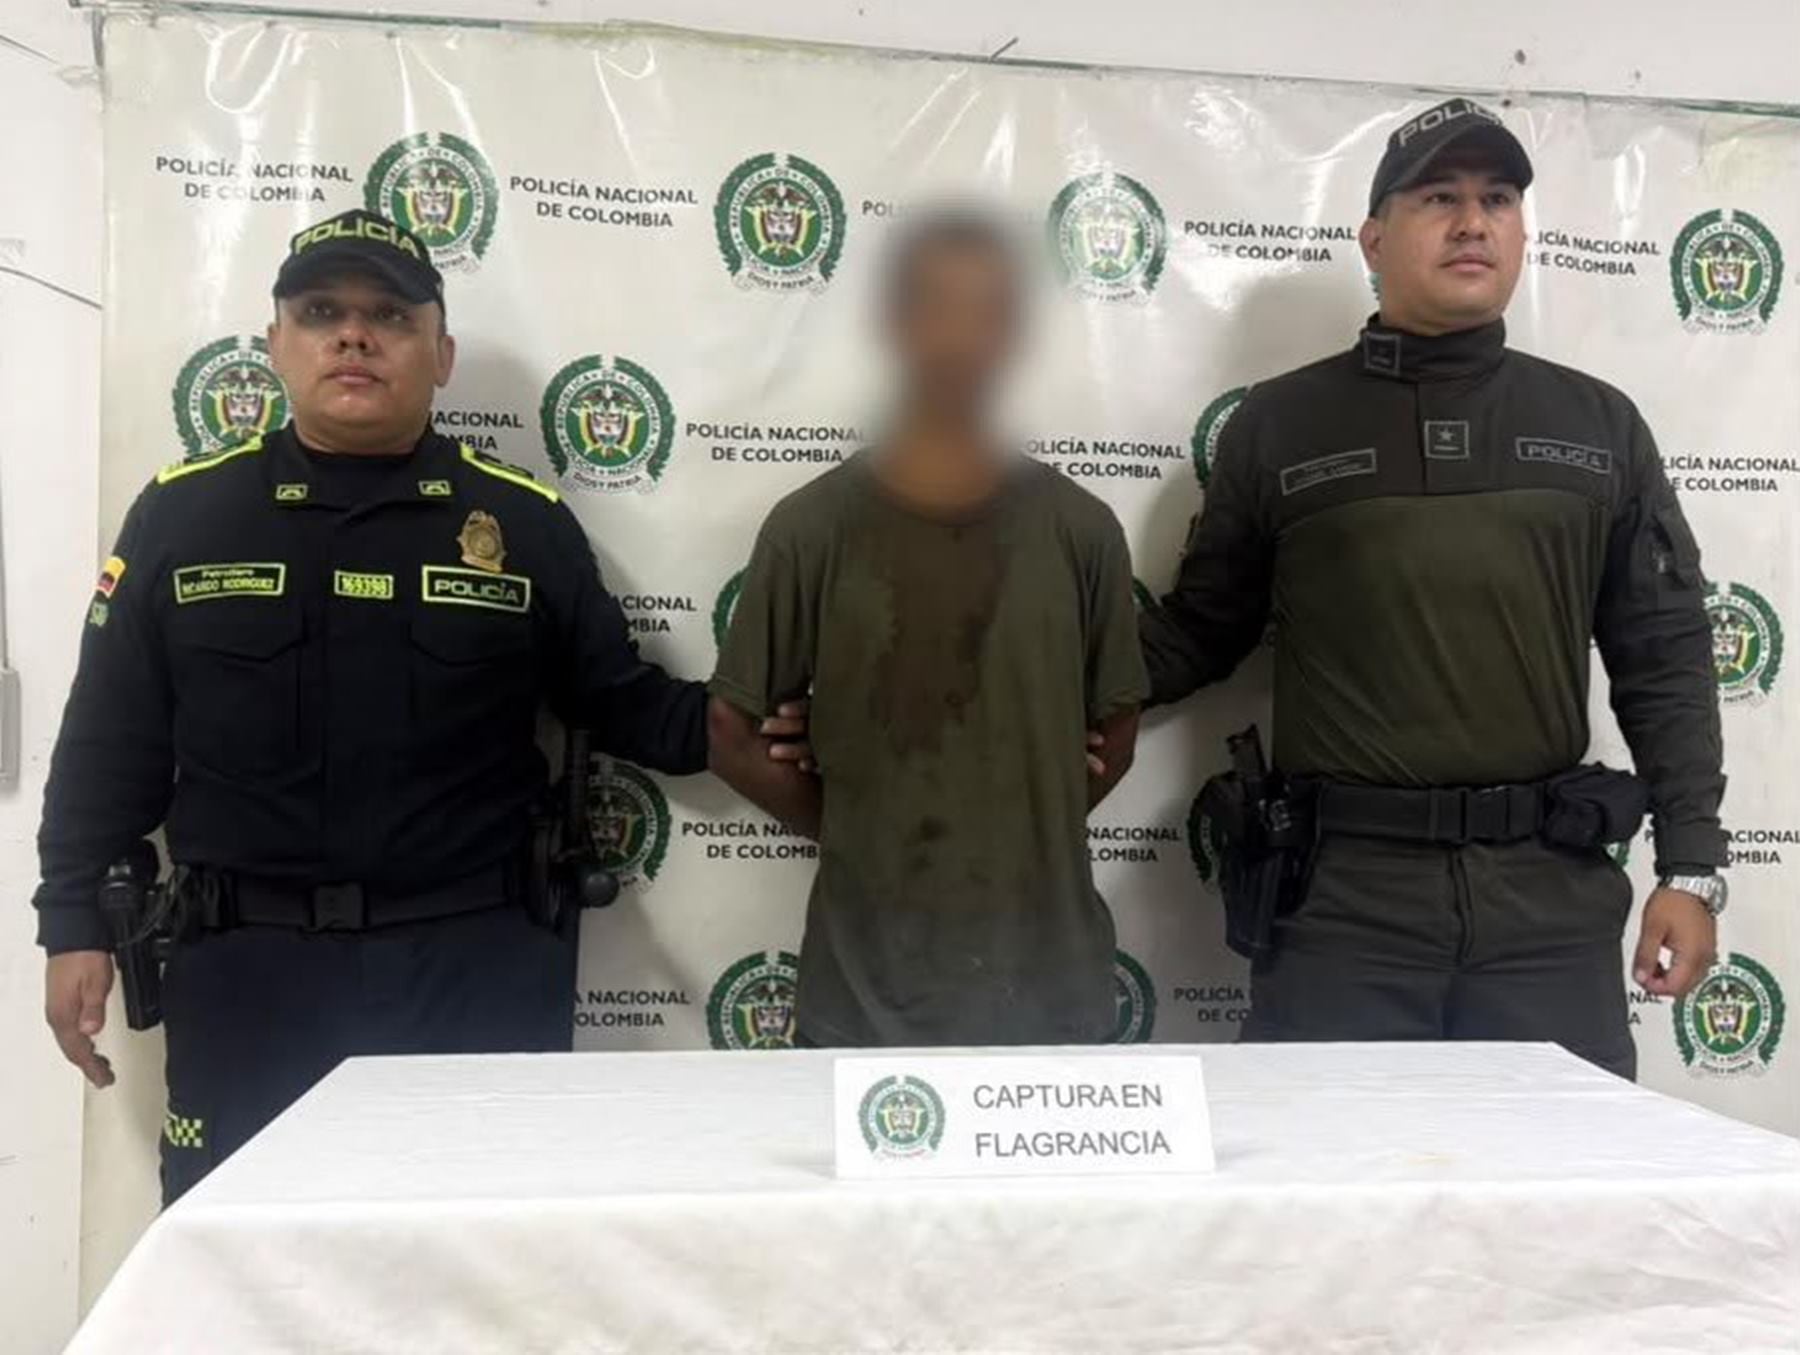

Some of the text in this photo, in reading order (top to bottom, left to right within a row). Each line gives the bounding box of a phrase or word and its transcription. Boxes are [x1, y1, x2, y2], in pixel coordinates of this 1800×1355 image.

[1399, 102, 1503, 147] POLIC
[156, 156, 354, 182] POLICÍA NACIONAL
[184, 183, 210, 198] DE
[510, 176, 699, 204] POLICÍA NACIONAL
[536, 201, 673, 227] DE COLOMBIA
[1184, 220, 1357, 240] POLICÍA NACIONAL
[1538, 229, 1661, 256] ICÍA NACIONAL
[1208, 244, 1332, 262] DE COLOMBIA
[1554, 254, 1637, 276] COLOMBIA
[433, 411, 525, 429] ACIONAL
[686, 423, 763, 441] POLICÍA
[711, 447, 843, 463] DE COLOMBIA
[1026, 437, 1186, 460] OLICÍA NACIONAL
[1067, 463, 1162, 479] COLOMBIA
[1662, 454, 1800, 472] LICÍA NACIONAL
[1672, 477, 1778, 492] E COLOMBIA
[434, 578, 520, 604] POLICÍA
[622, 595, 698, 612] CIONAL
[626, 618, 670, 632] MBIA
[682, 819, 758, 837] POLICÍA
[1086, 827, 1182, 841] NACIONAL
[707, 845, 818, 859] DE COLOMB
[1088, 847, 1159, 863] LOMBIA
[1725, 850, 1782, 864] OMBIA
[588, 990, 692, 1005] NACIONAL
[575, 1012, 665, 1027] OLOMBIA
[1198, 1009, 1221, 1022] DE
[973, 1084, 1162, 1109] CAPTURA EN
[975, 1130, 1172, 1158] FLAGRANCIA
